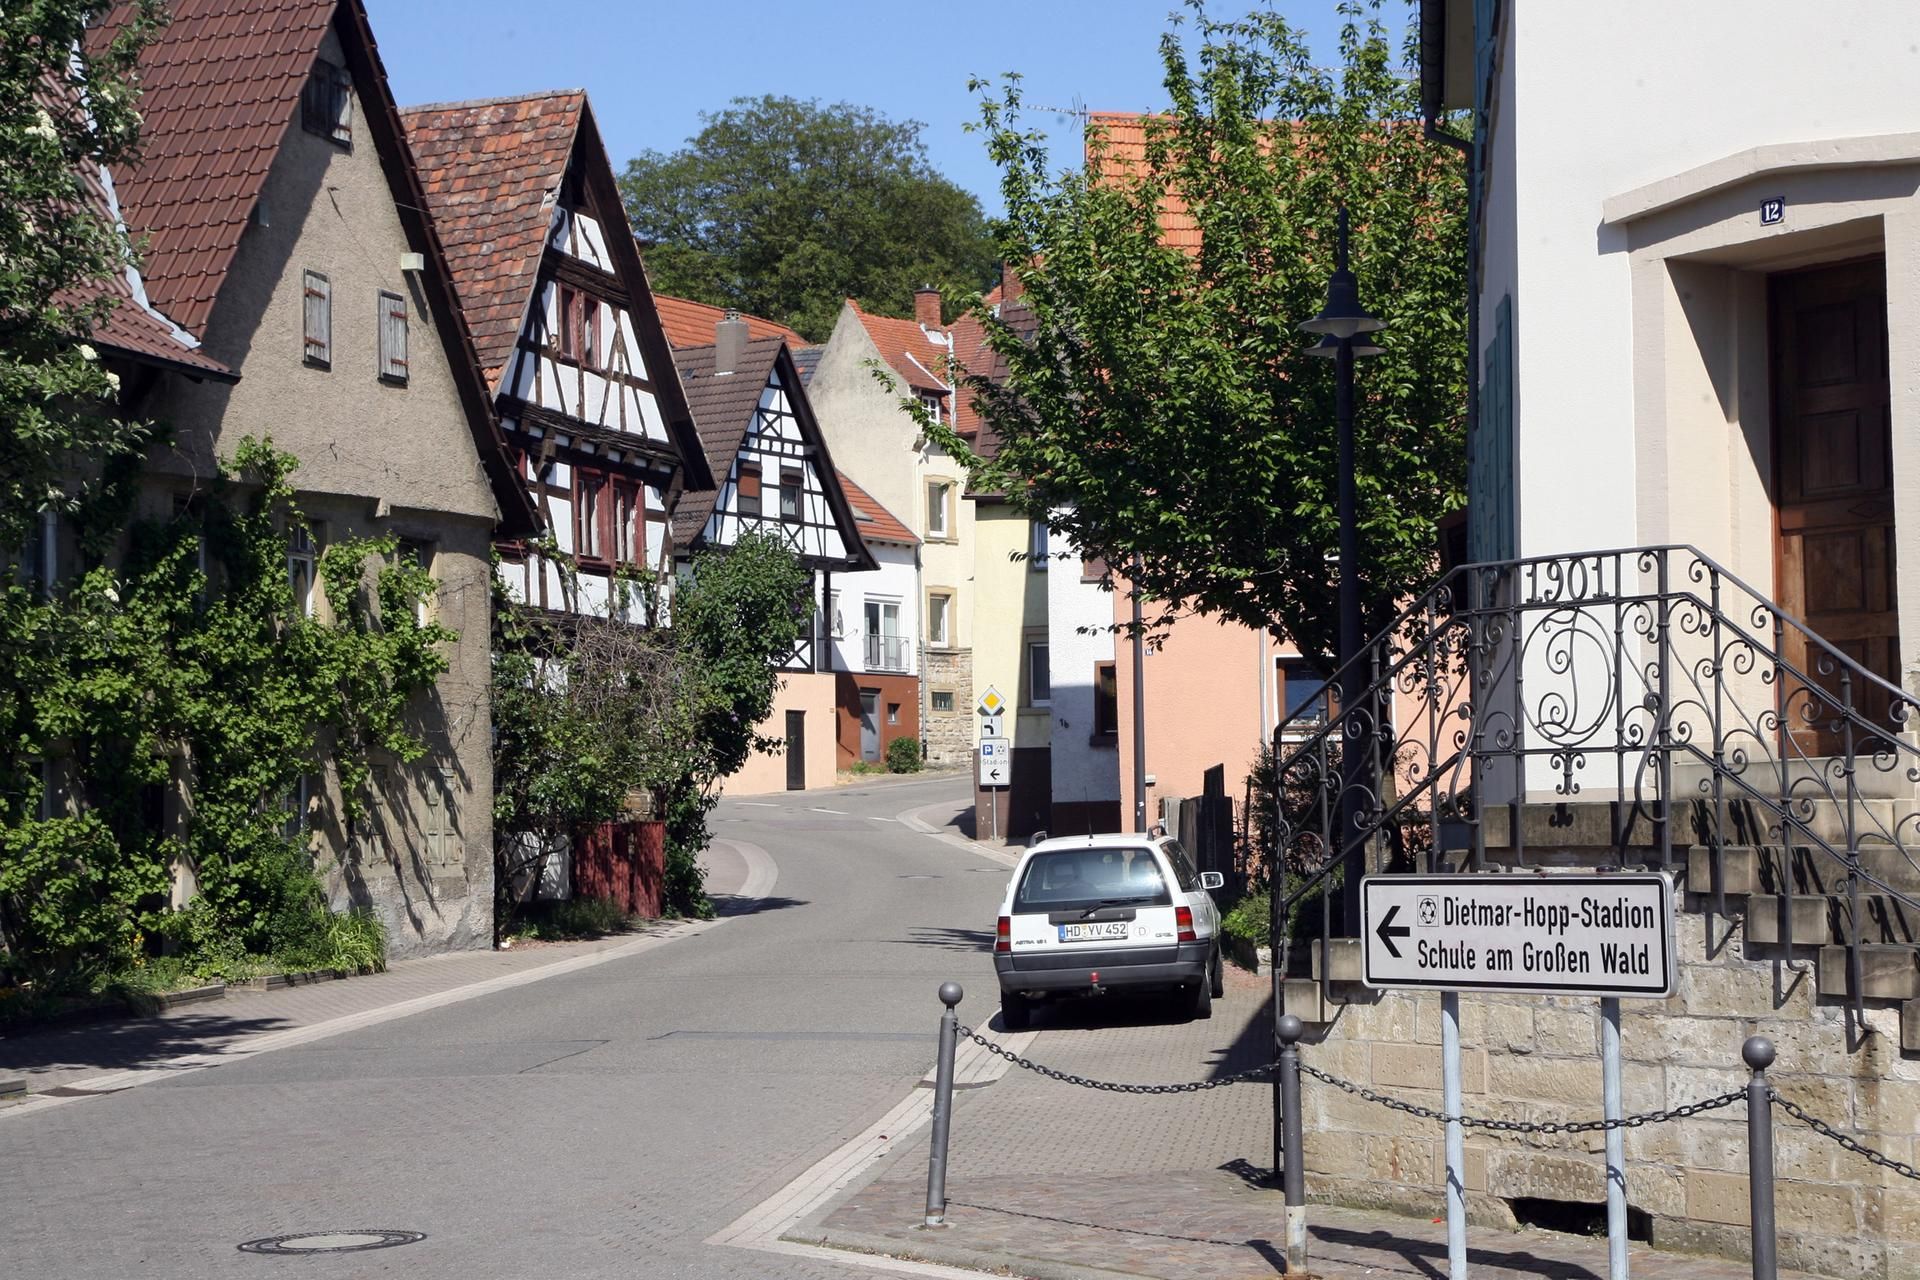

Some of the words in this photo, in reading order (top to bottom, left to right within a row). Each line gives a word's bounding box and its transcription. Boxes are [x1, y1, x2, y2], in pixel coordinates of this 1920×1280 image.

[1764, 202, 1780, 221] 12
[1526, 556, 1610, 603] 1901
[984, 745, 992, 755] P
[983, 758, 1008, 766] Stadion
[1443, 896, 1655, 936] Dietmar-Hopp-Stadion
[1066, 925, 1081, 937] HD
[1088, 924, 1103, 936] YV
[1105, 923, 1127, 935] 452
[1417, 939, 1477, 970] Schule
[1486, 948, 1513, 971] am
[1522, 941, 1590, 973] Großen
[1600, 942, 1650, 975] Wald
